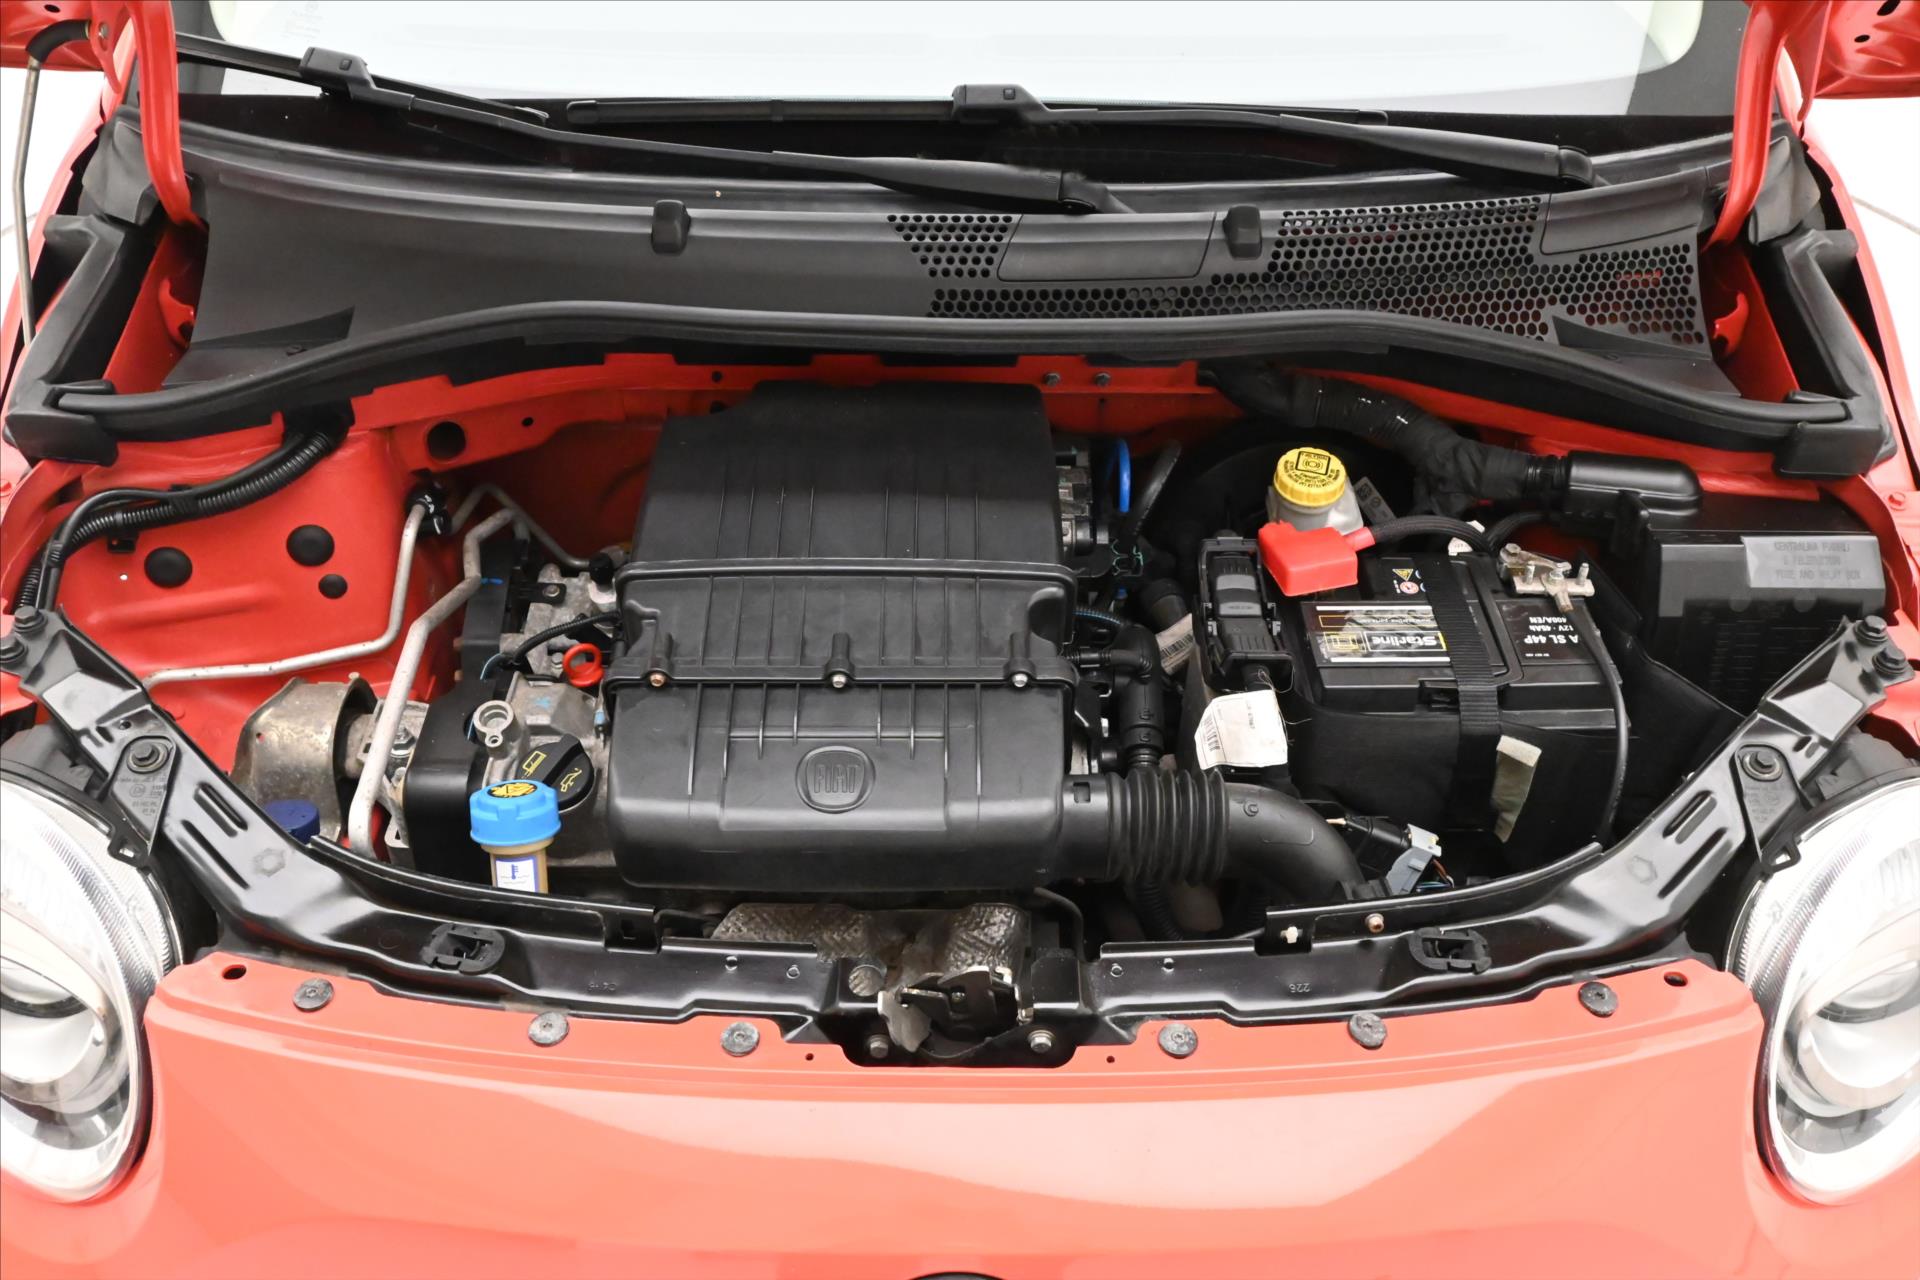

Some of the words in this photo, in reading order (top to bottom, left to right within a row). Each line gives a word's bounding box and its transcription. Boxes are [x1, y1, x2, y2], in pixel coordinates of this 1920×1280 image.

[1558, 624, 1574, 632] 12V
[1371, 635, 1438, 647] Starline
[1523, 634, 1547, 645] 44P
[1548, 634, 1568, 645] SL
[1568, 634, 1579, 644] A
[813, 763, 860, 794] FIAT
